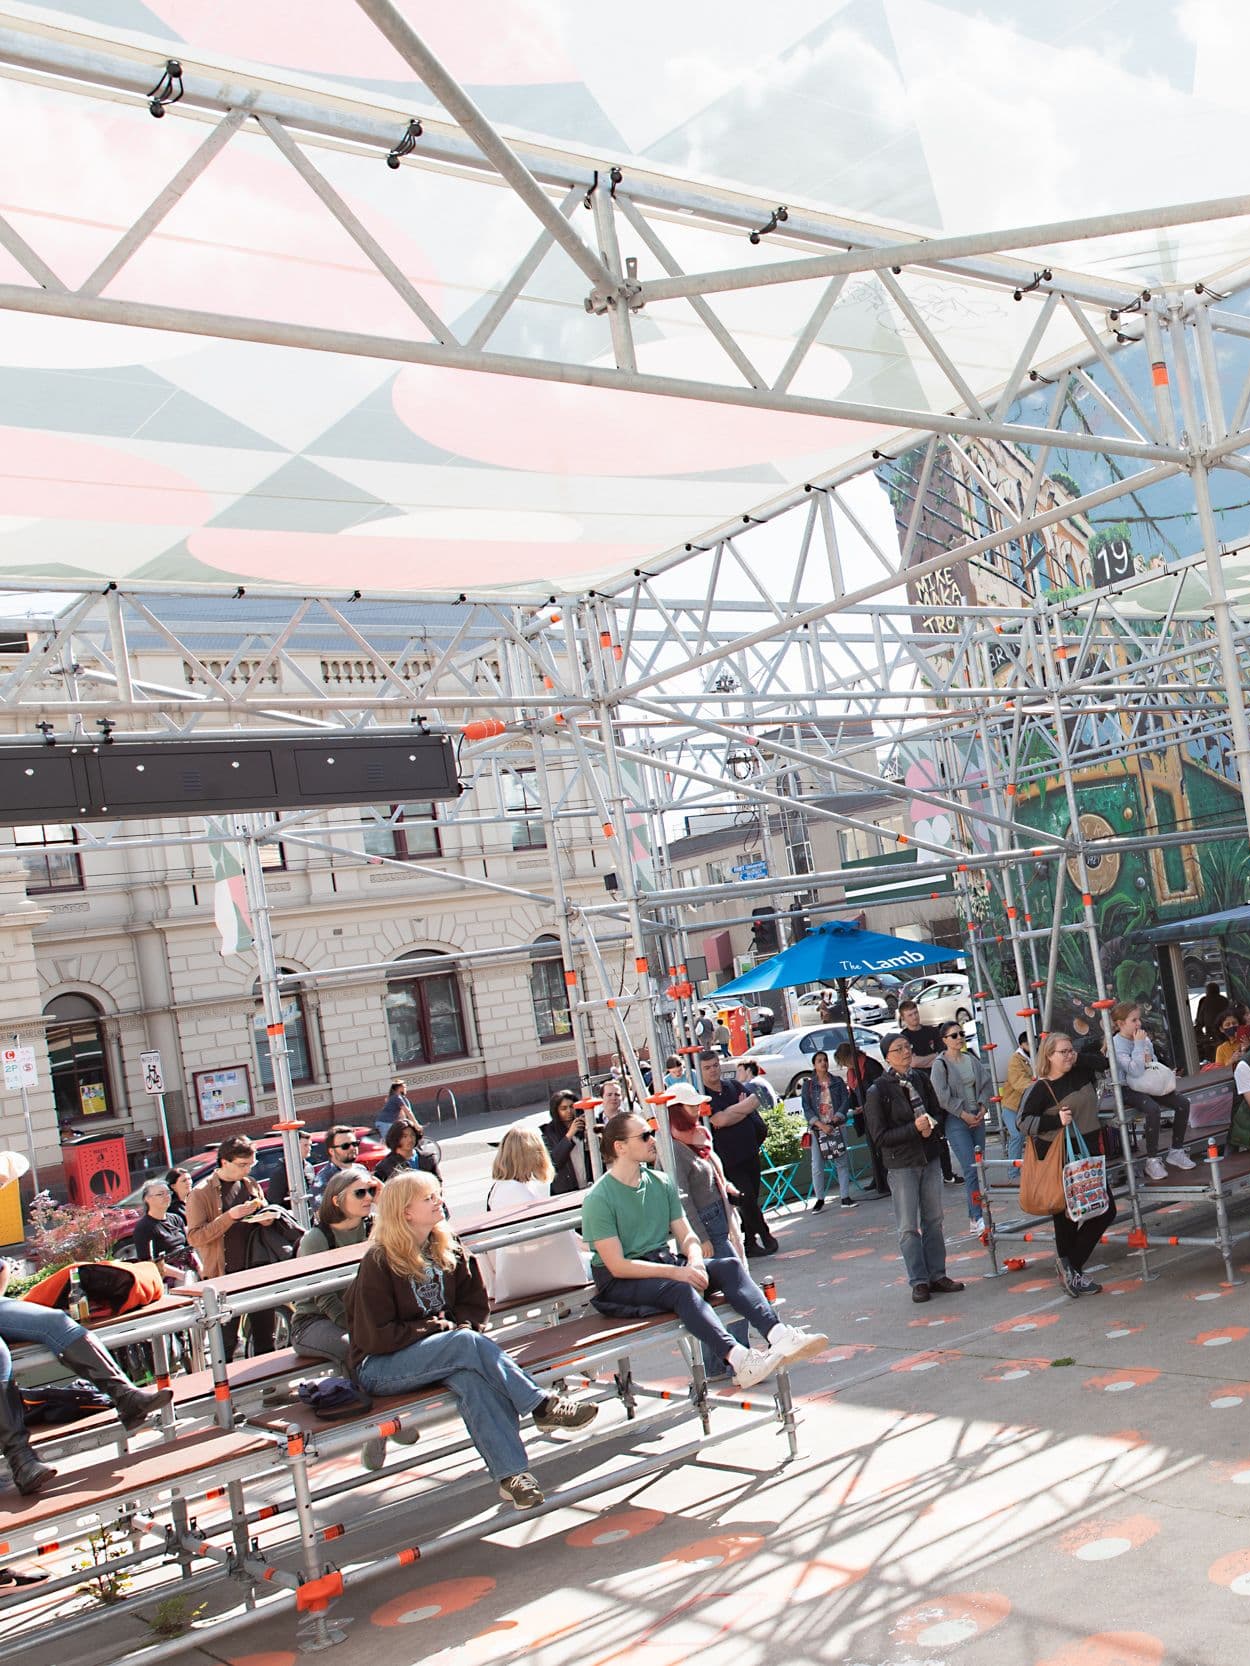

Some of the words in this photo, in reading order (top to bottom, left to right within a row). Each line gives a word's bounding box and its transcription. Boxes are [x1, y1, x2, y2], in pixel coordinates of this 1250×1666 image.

[1097, 541, 1129, 579] 19
[915, 566, 955, 601] MIKE
[839, 960, 862, 971] The
[862, 950, 925, 971] Lamb
